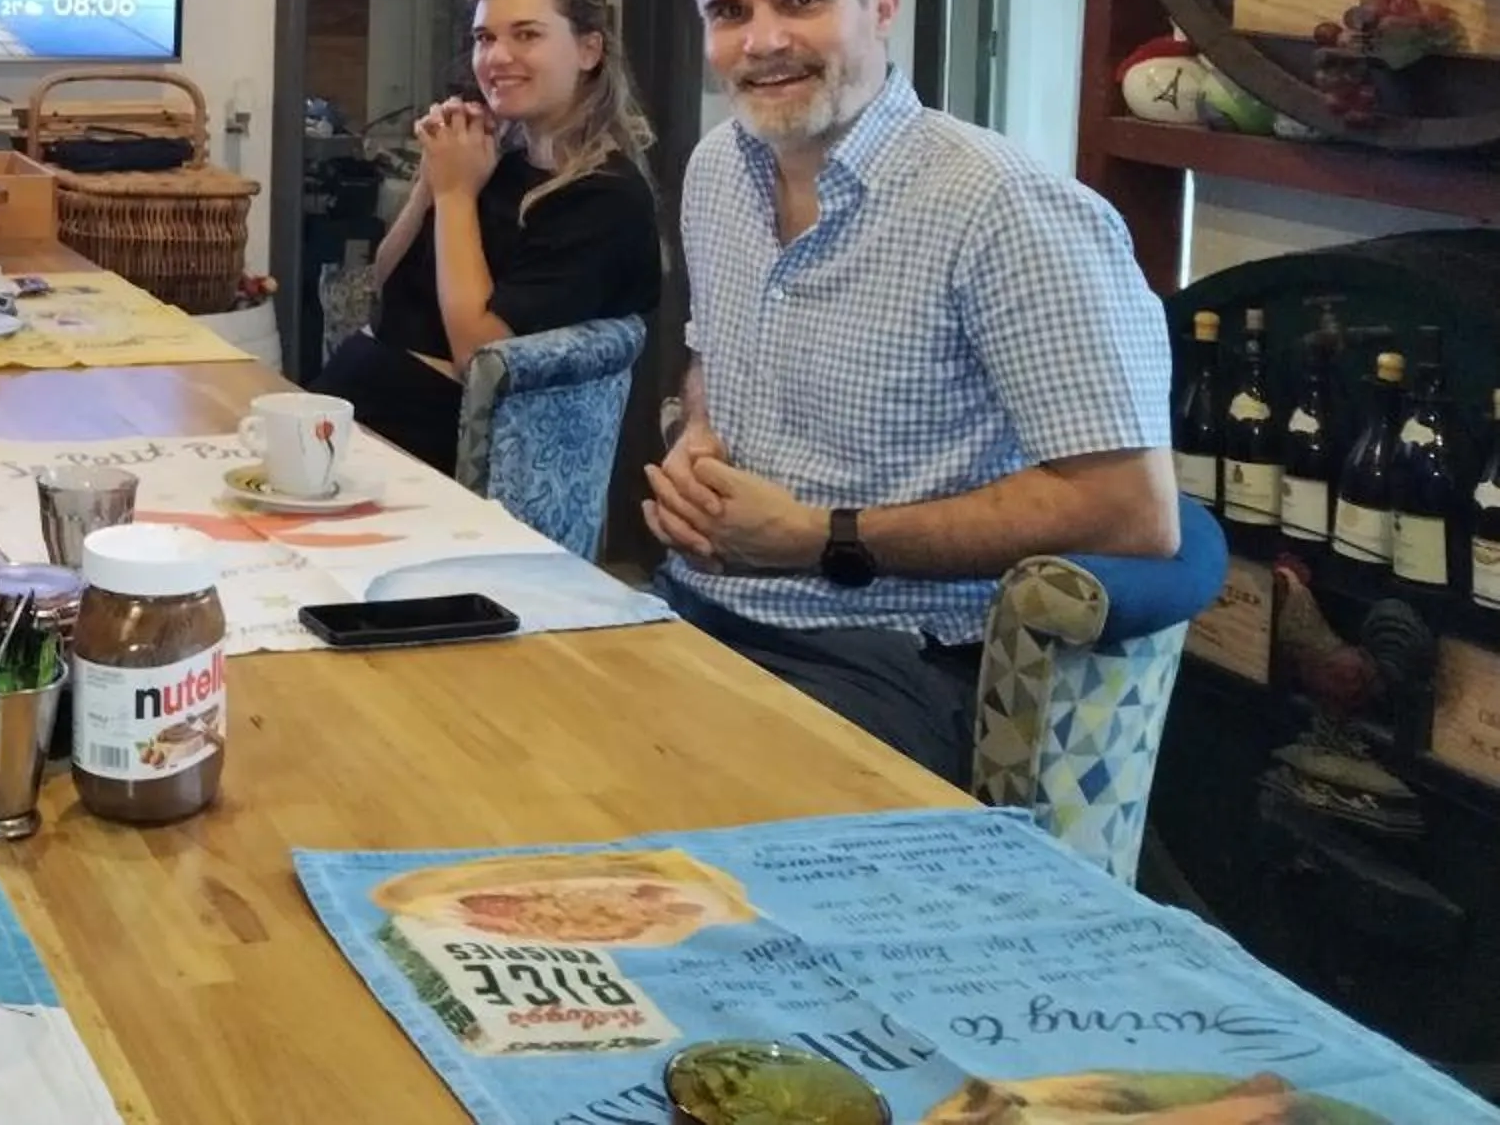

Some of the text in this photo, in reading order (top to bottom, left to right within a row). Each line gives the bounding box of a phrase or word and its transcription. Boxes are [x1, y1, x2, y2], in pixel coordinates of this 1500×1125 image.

[134, 649, 225, 720] nutell
[444, 941, 603, 965] KRISPIES
[463, 964, 636, 1006] RICE
[949, 1016, 1020, 1047] to
